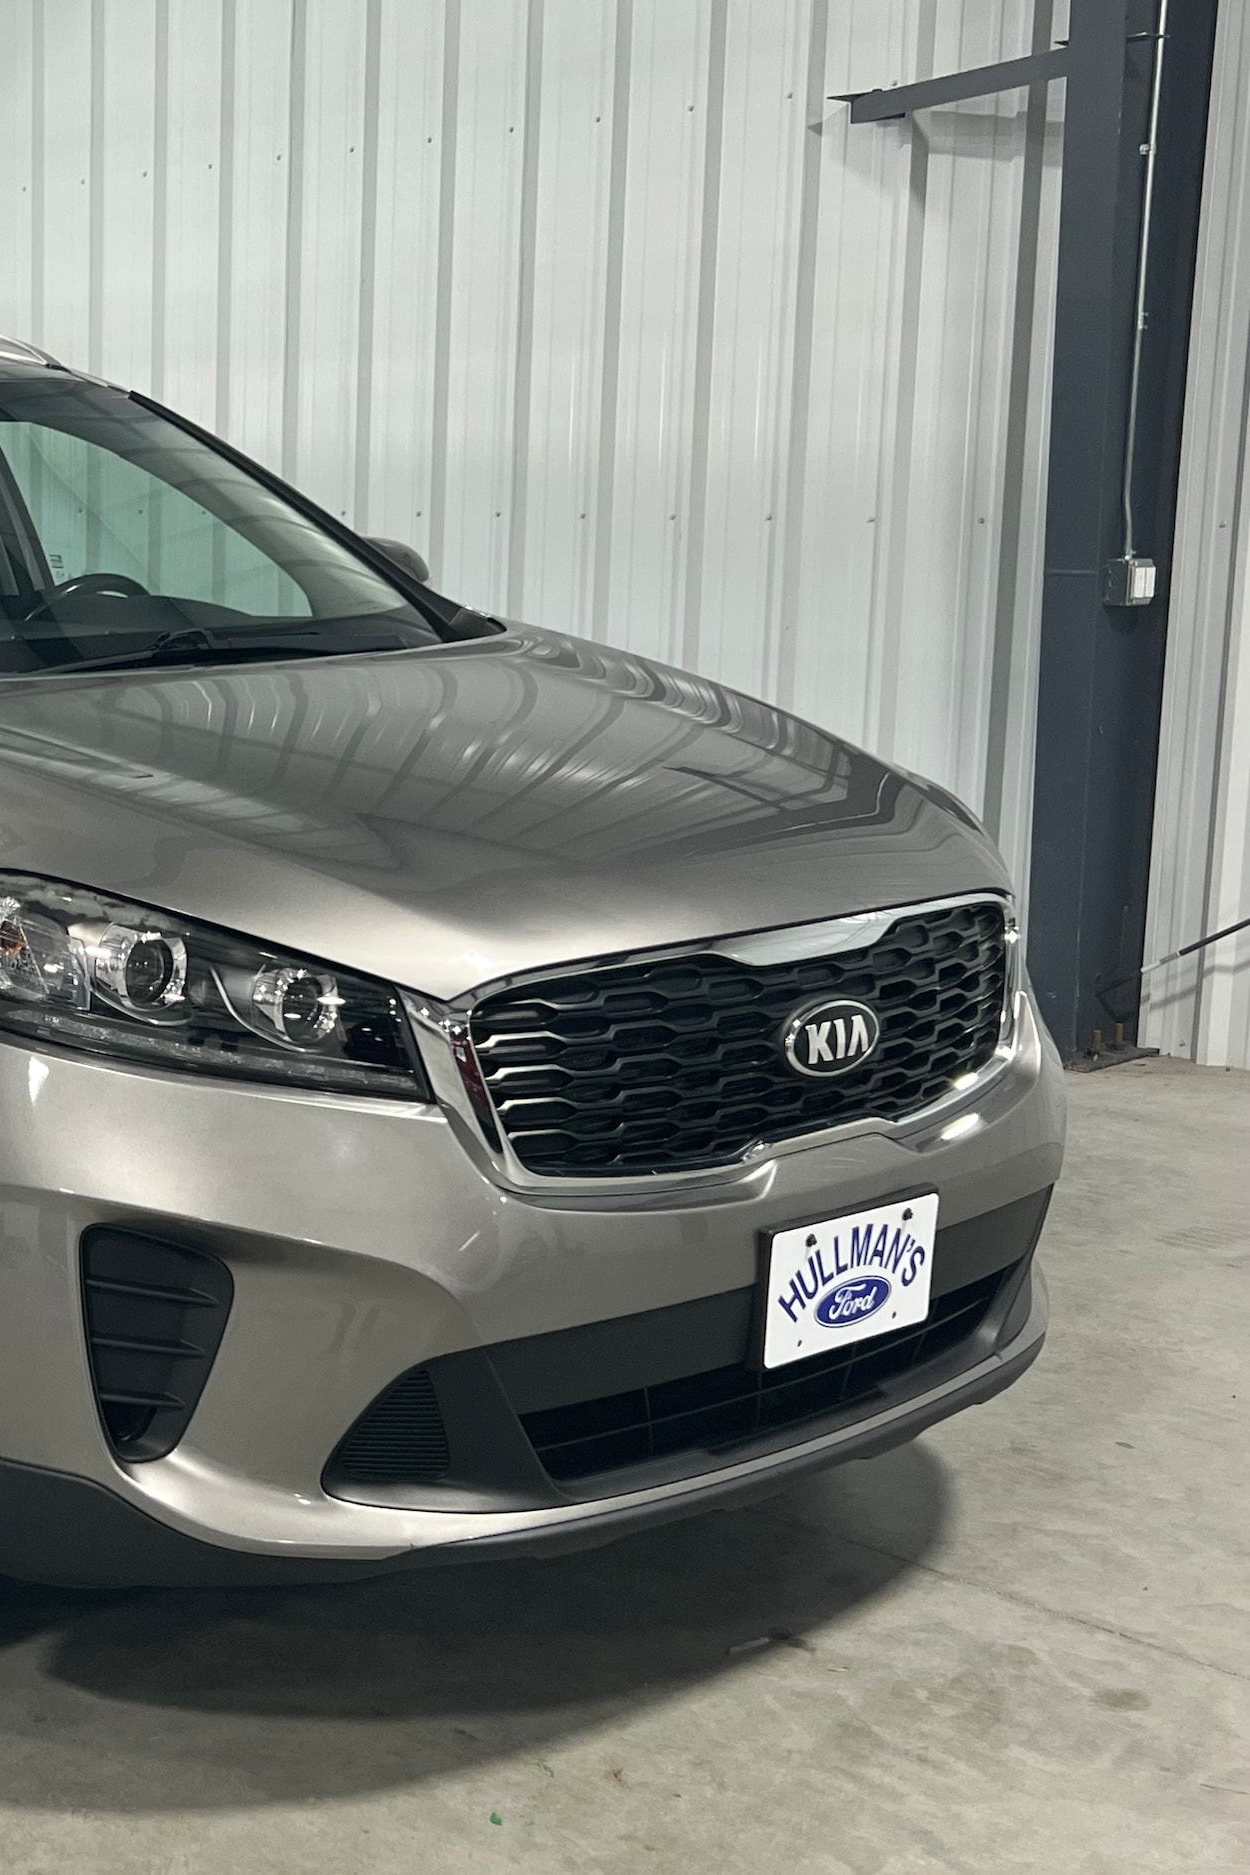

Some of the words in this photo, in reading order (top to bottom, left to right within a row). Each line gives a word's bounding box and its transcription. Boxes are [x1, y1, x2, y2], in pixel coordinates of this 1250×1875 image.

[805, 1014, 869, 1065] KIA
[778, 1223, 926, 1323] HULLMAN'S
[828, 1283, 878, 1320] Ford
